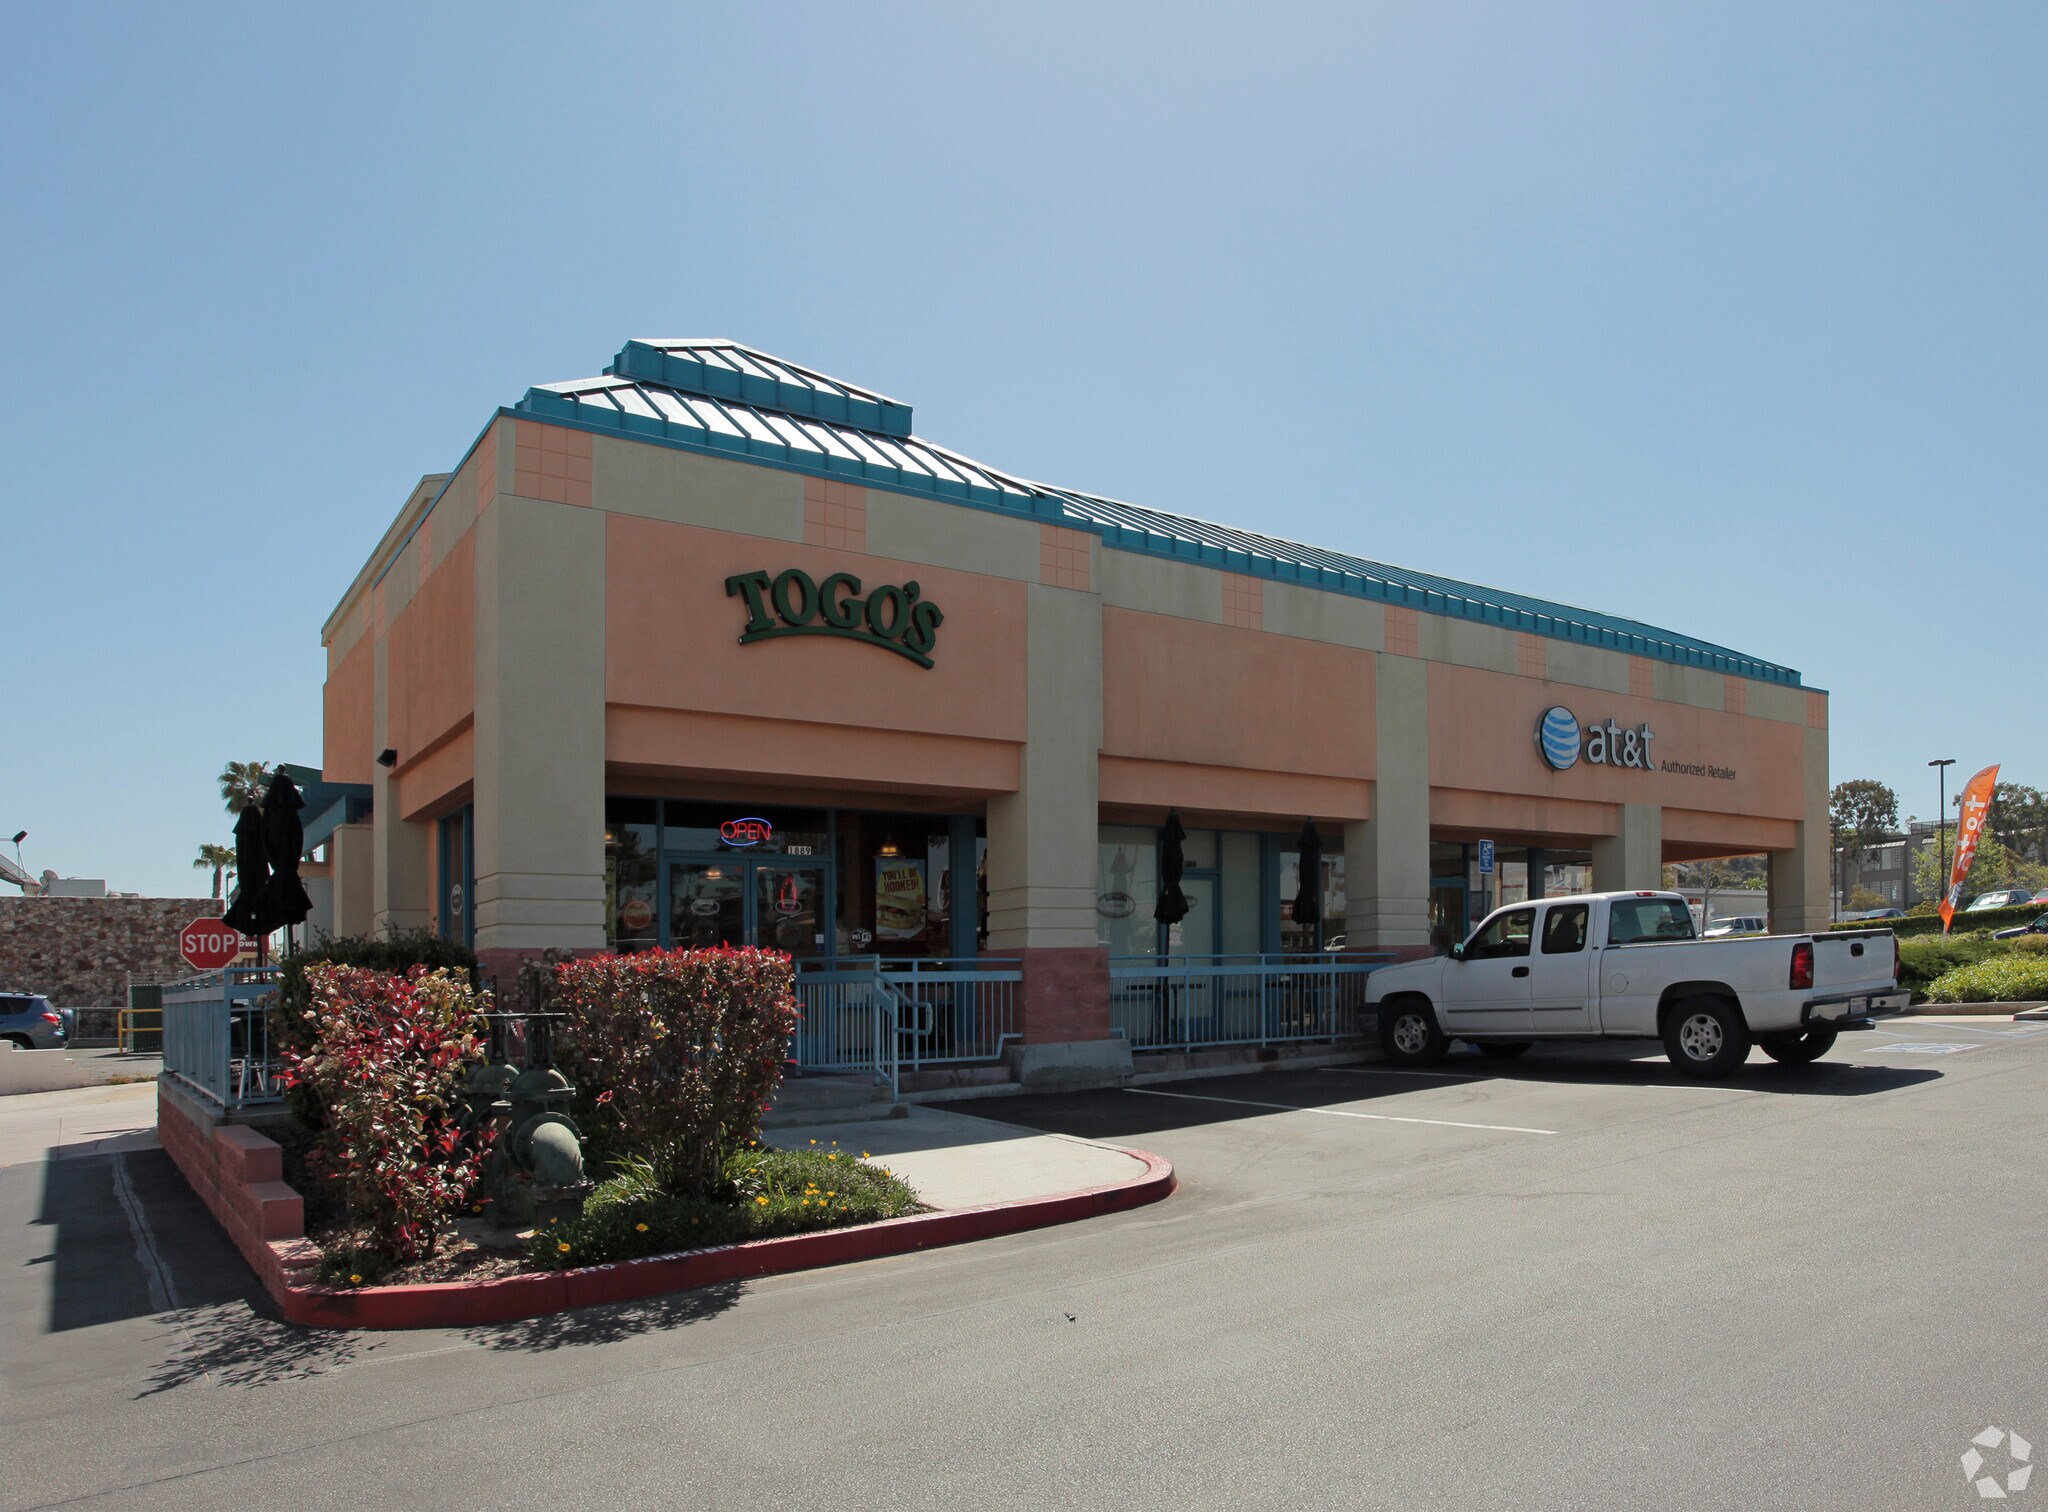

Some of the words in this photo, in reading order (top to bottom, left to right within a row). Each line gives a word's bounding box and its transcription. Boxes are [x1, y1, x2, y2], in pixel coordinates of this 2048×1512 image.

[725, 568, 944, 654] TOGO'S
[1583, 718, 1656, 771] at&t
[1661, 760, 1706, 777] Authorized
[1707, 765, 1736, 781] Retailer
[720, 821, 771, 841] OPEN
[788, 846, 811, 855] 1889
[882, 870, 907, 880] YOU'LL
[909, 868, 918, 877] BE
[884, 879, 919, 893] HOOKED!
[185, 934, 235, 953] STOP
